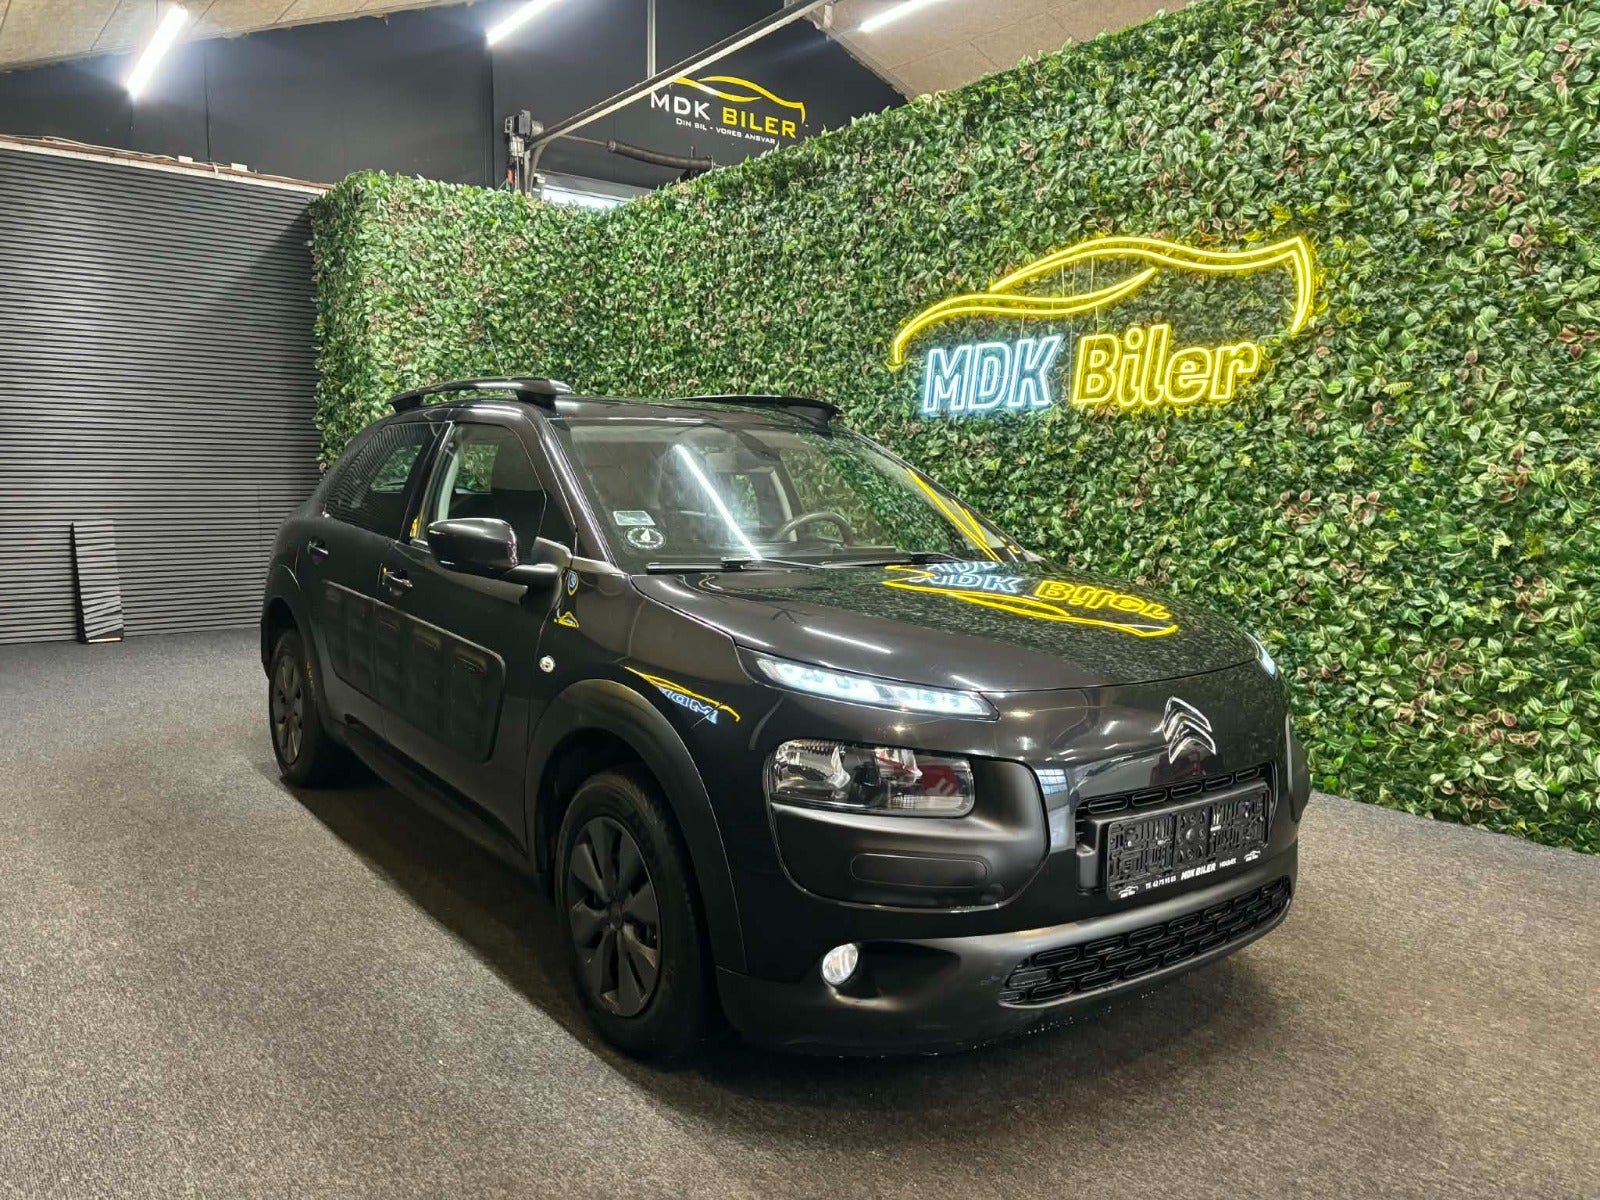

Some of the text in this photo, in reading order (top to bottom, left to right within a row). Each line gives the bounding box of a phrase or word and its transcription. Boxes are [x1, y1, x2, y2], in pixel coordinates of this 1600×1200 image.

[650, 91, 796, 138] MDK BILER
[922, 324, 1261, 413] MDK Biler
[1195, 862, 1216, 876] BILER
